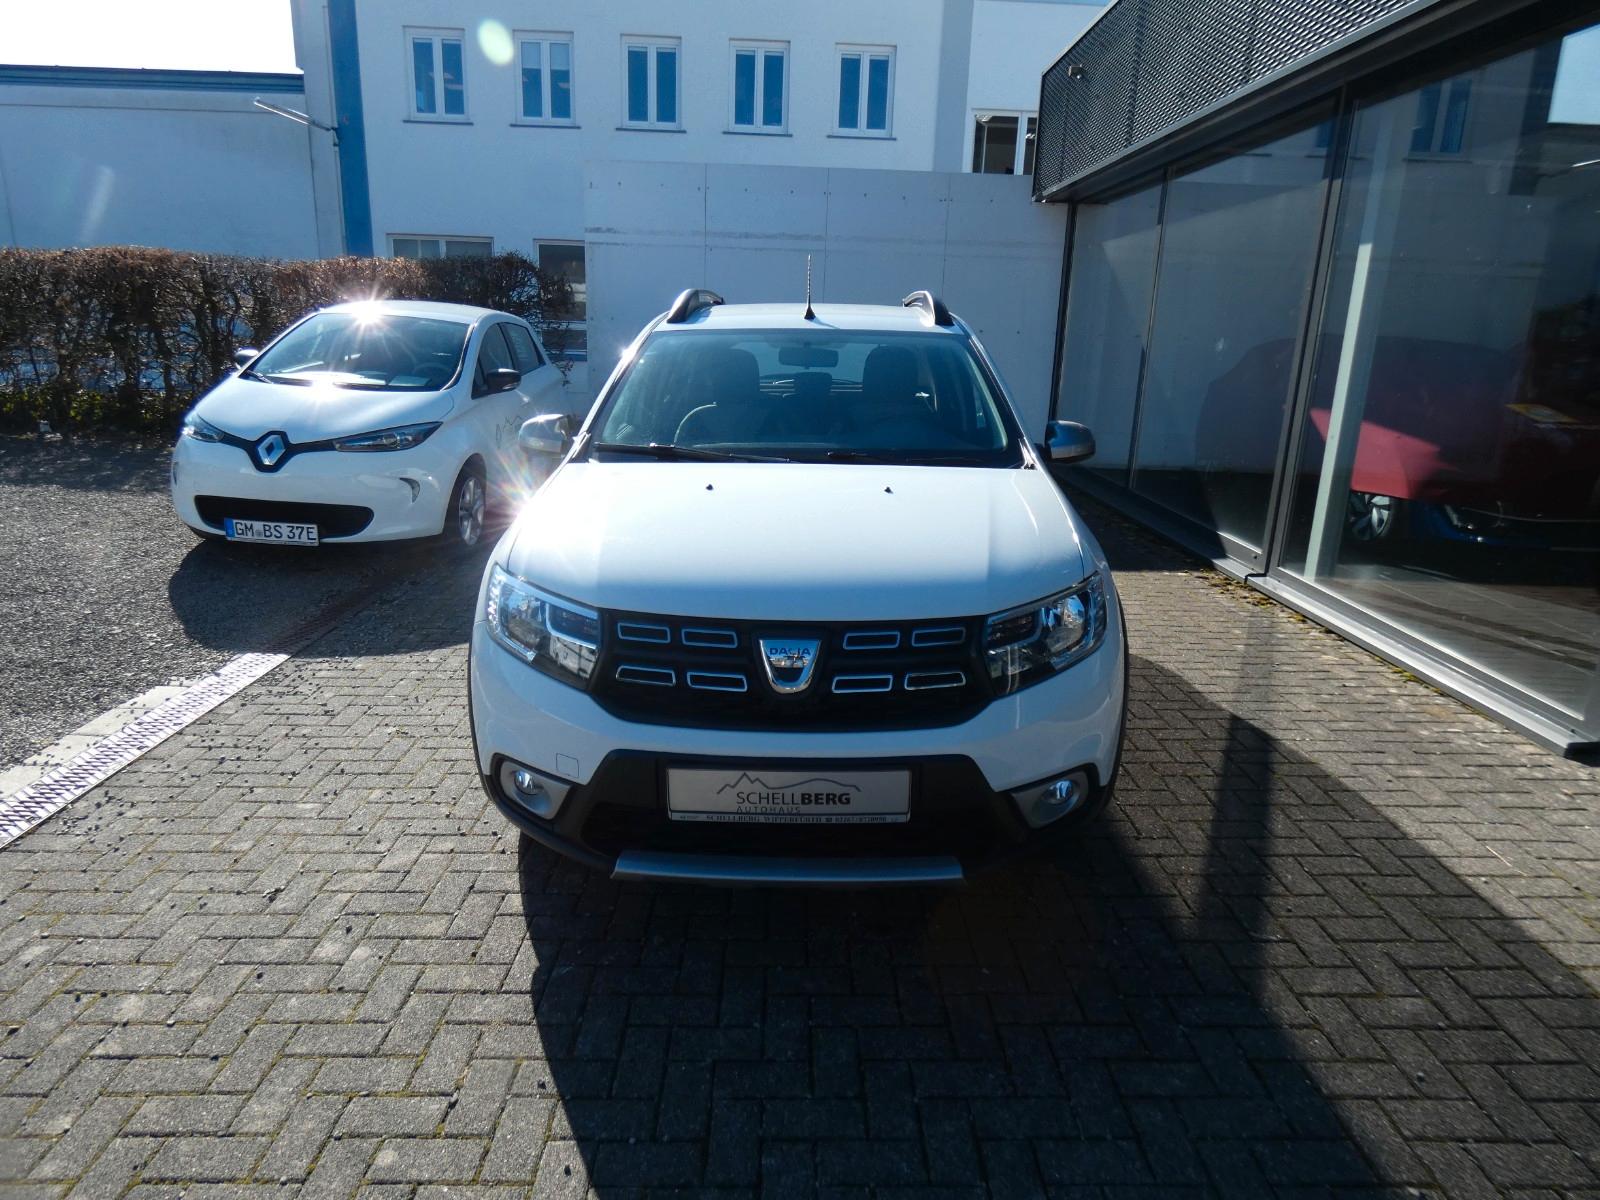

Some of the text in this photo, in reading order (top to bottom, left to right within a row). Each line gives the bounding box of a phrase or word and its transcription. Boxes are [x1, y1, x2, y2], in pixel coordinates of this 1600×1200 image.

[235, 521, 316, 541] GM BS 37E
[769, 647, 811, 656] DACIA
[736, 791, 850, 806] SCHELLBERG
[736, 806, 801, 815] AUTOHAUS
